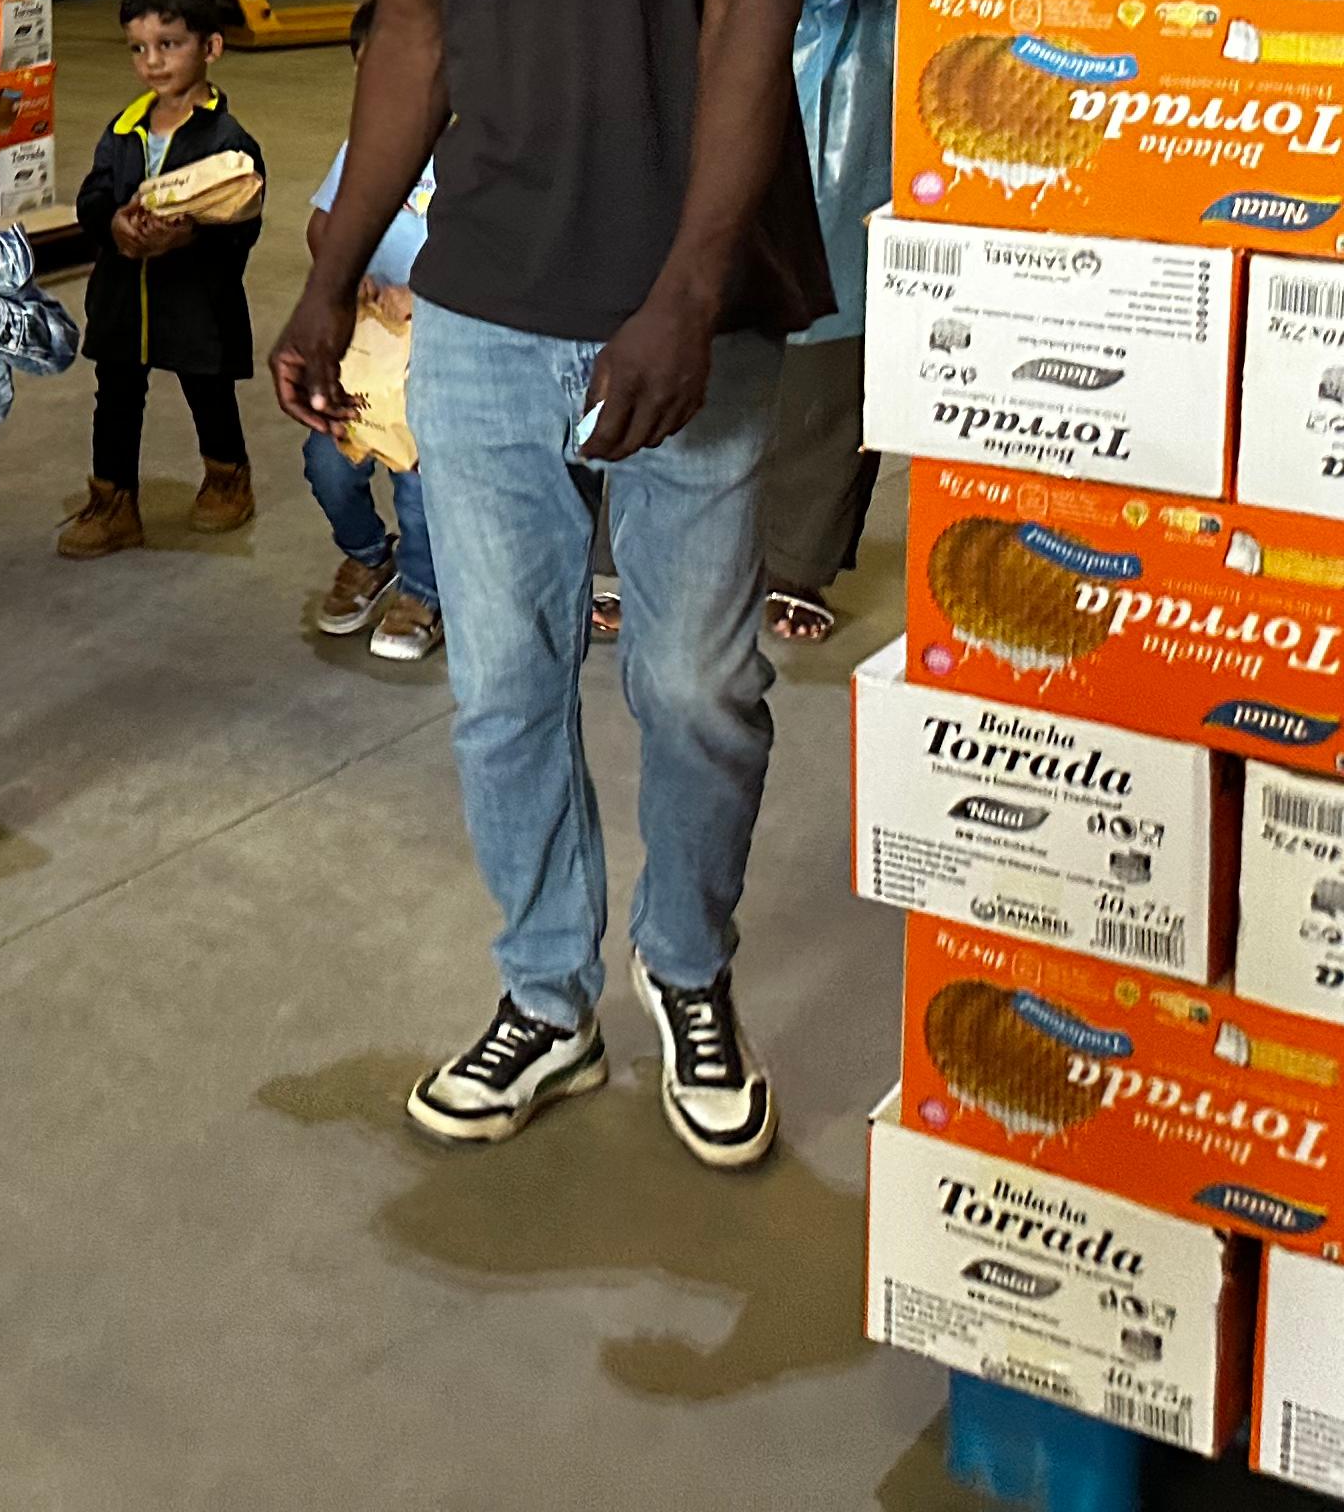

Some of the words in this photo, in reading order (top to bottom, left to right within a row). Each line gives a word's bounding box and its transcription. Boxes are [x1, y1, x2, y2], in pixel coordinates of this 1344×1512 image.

[1018, 37, 1128, 80] Tradicional
[1069, 88, 1343, 156] Torrada
[1139, 134, 1263, 169] Bolacha
[1232, 197, 1308, 226] Natal
[885, 273, 955, 301] 40x75g
[932, 402, 1131, 462] Torrada
[1074, 583, 1343, 675] Torrada
[1142, 633, 1264, 681] Bolacha
[979, 711, 1076, 751] Bolacha
[922, 716, 1133, 796] Torrada
[966, 801, 1025, 828] Natal
[1094, 892, 1185, 931] 40x75g
[1067, 1055, 1328, 1170] Torrada
[1134, 1111, 1253, 1166] Bolacha
[993, 1177, 1088, 1226] Bolacha
[938, 1176, 1145, 1277] Torrada
